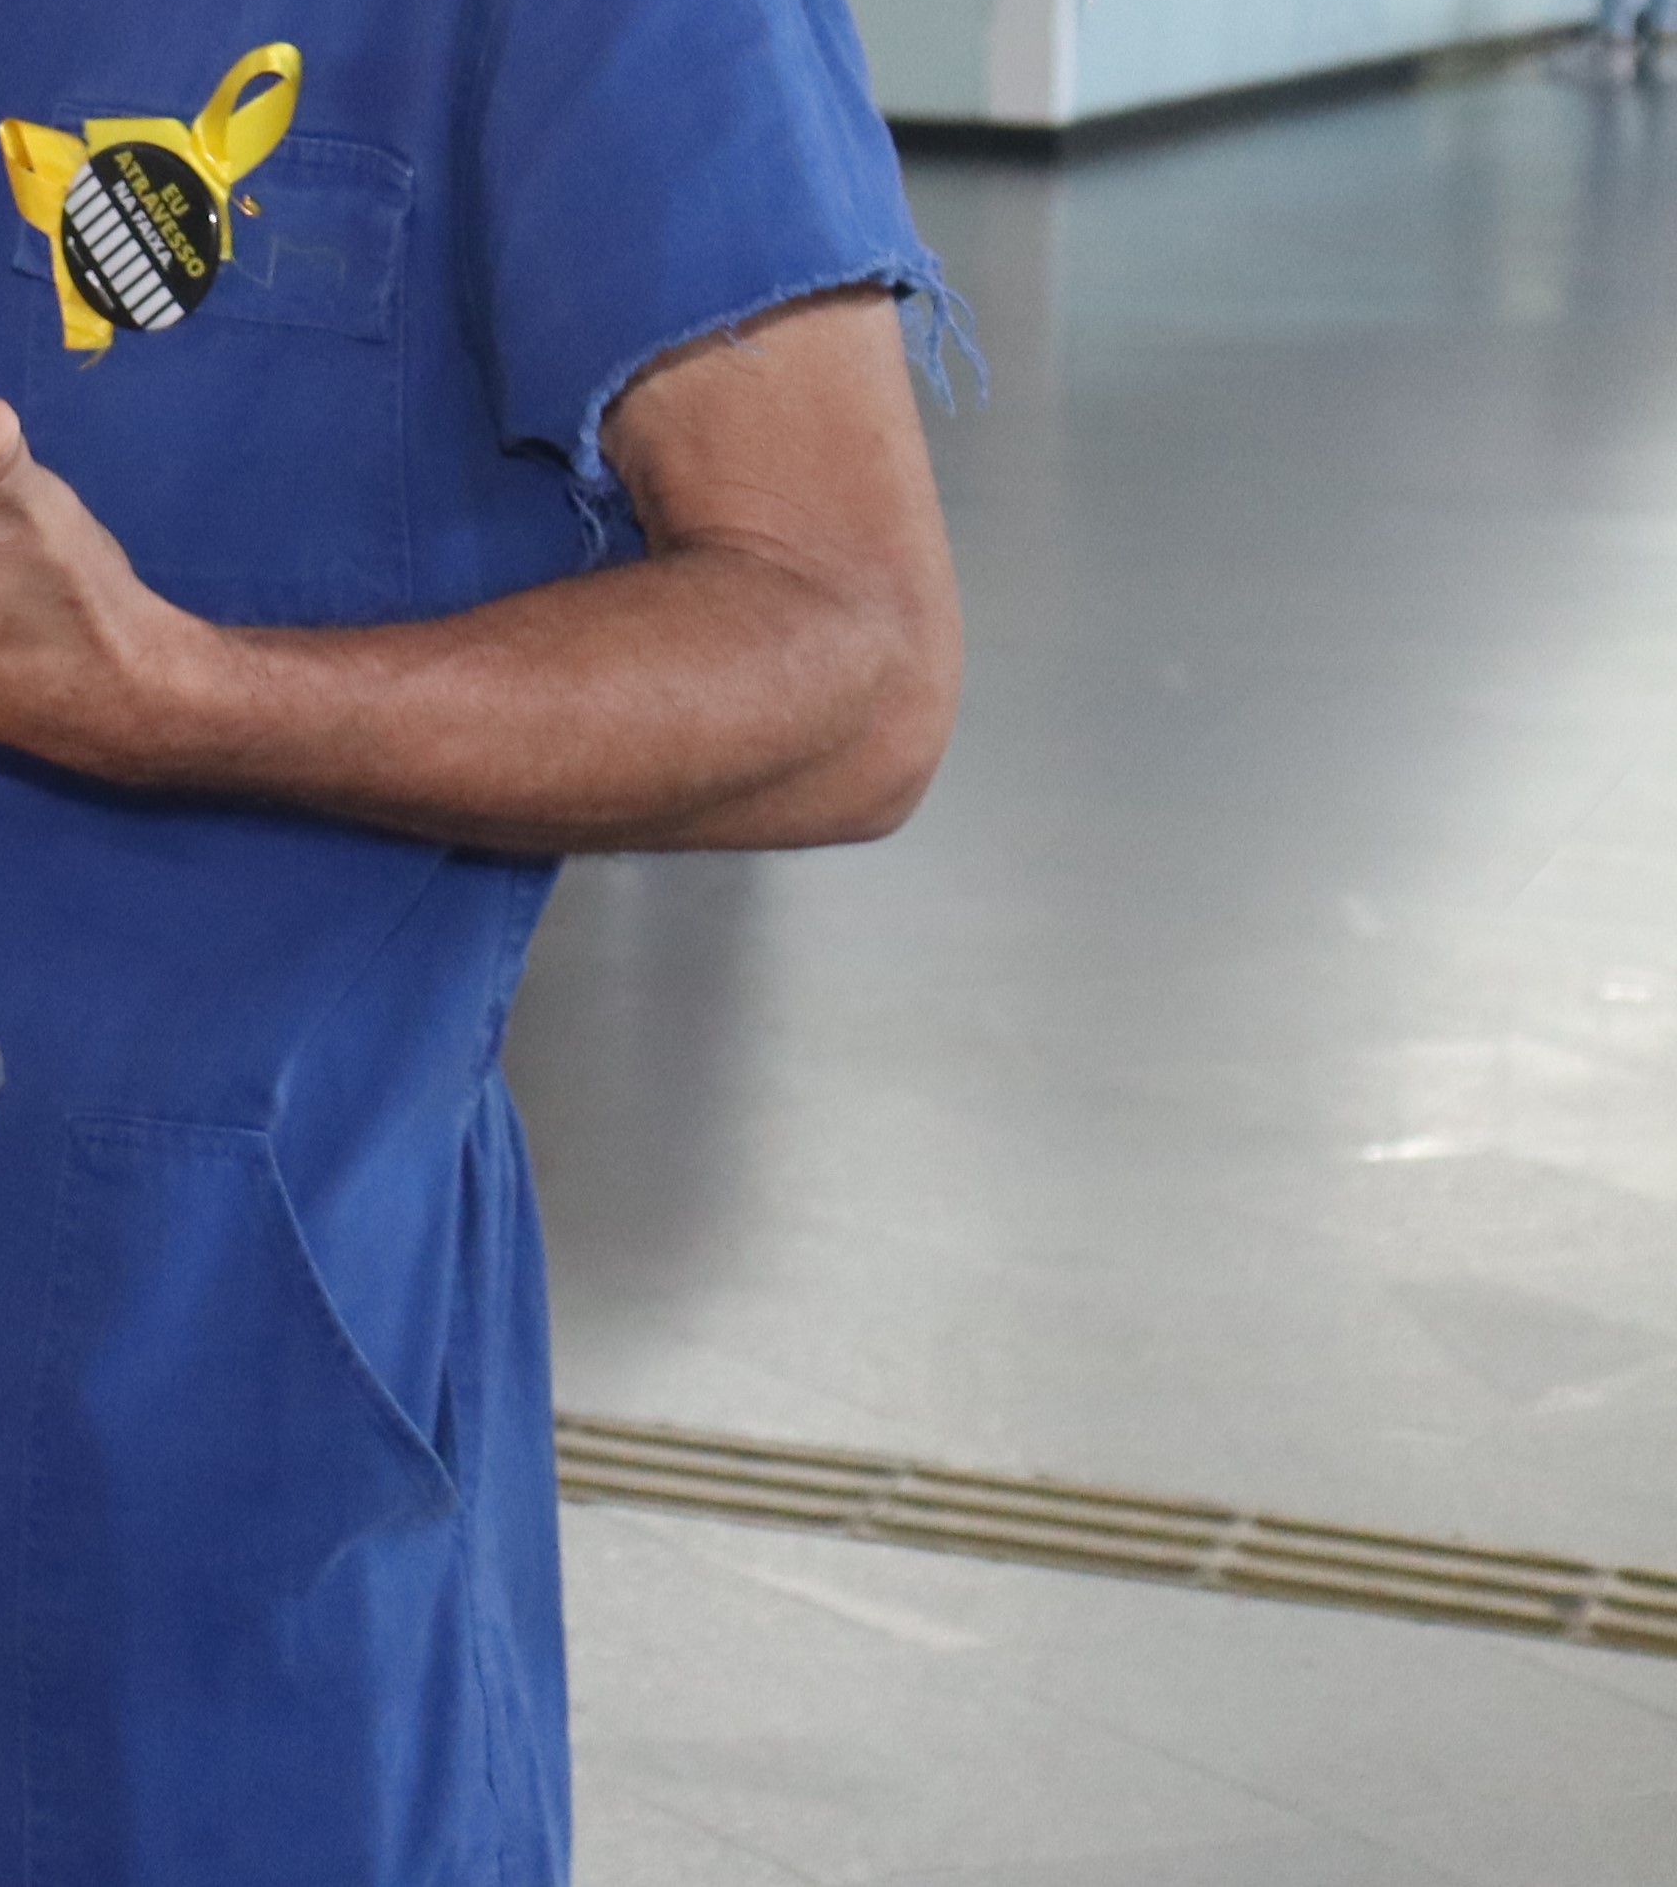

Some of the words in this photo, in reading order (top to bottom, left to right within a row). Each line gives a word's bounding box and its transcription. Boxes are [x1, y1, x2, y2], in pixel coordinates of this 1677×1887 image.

[111, 179, 137, 213] NA
[160, 182, 191, 217] EU
[113, 150, 206, 278] ATRAVESSO
